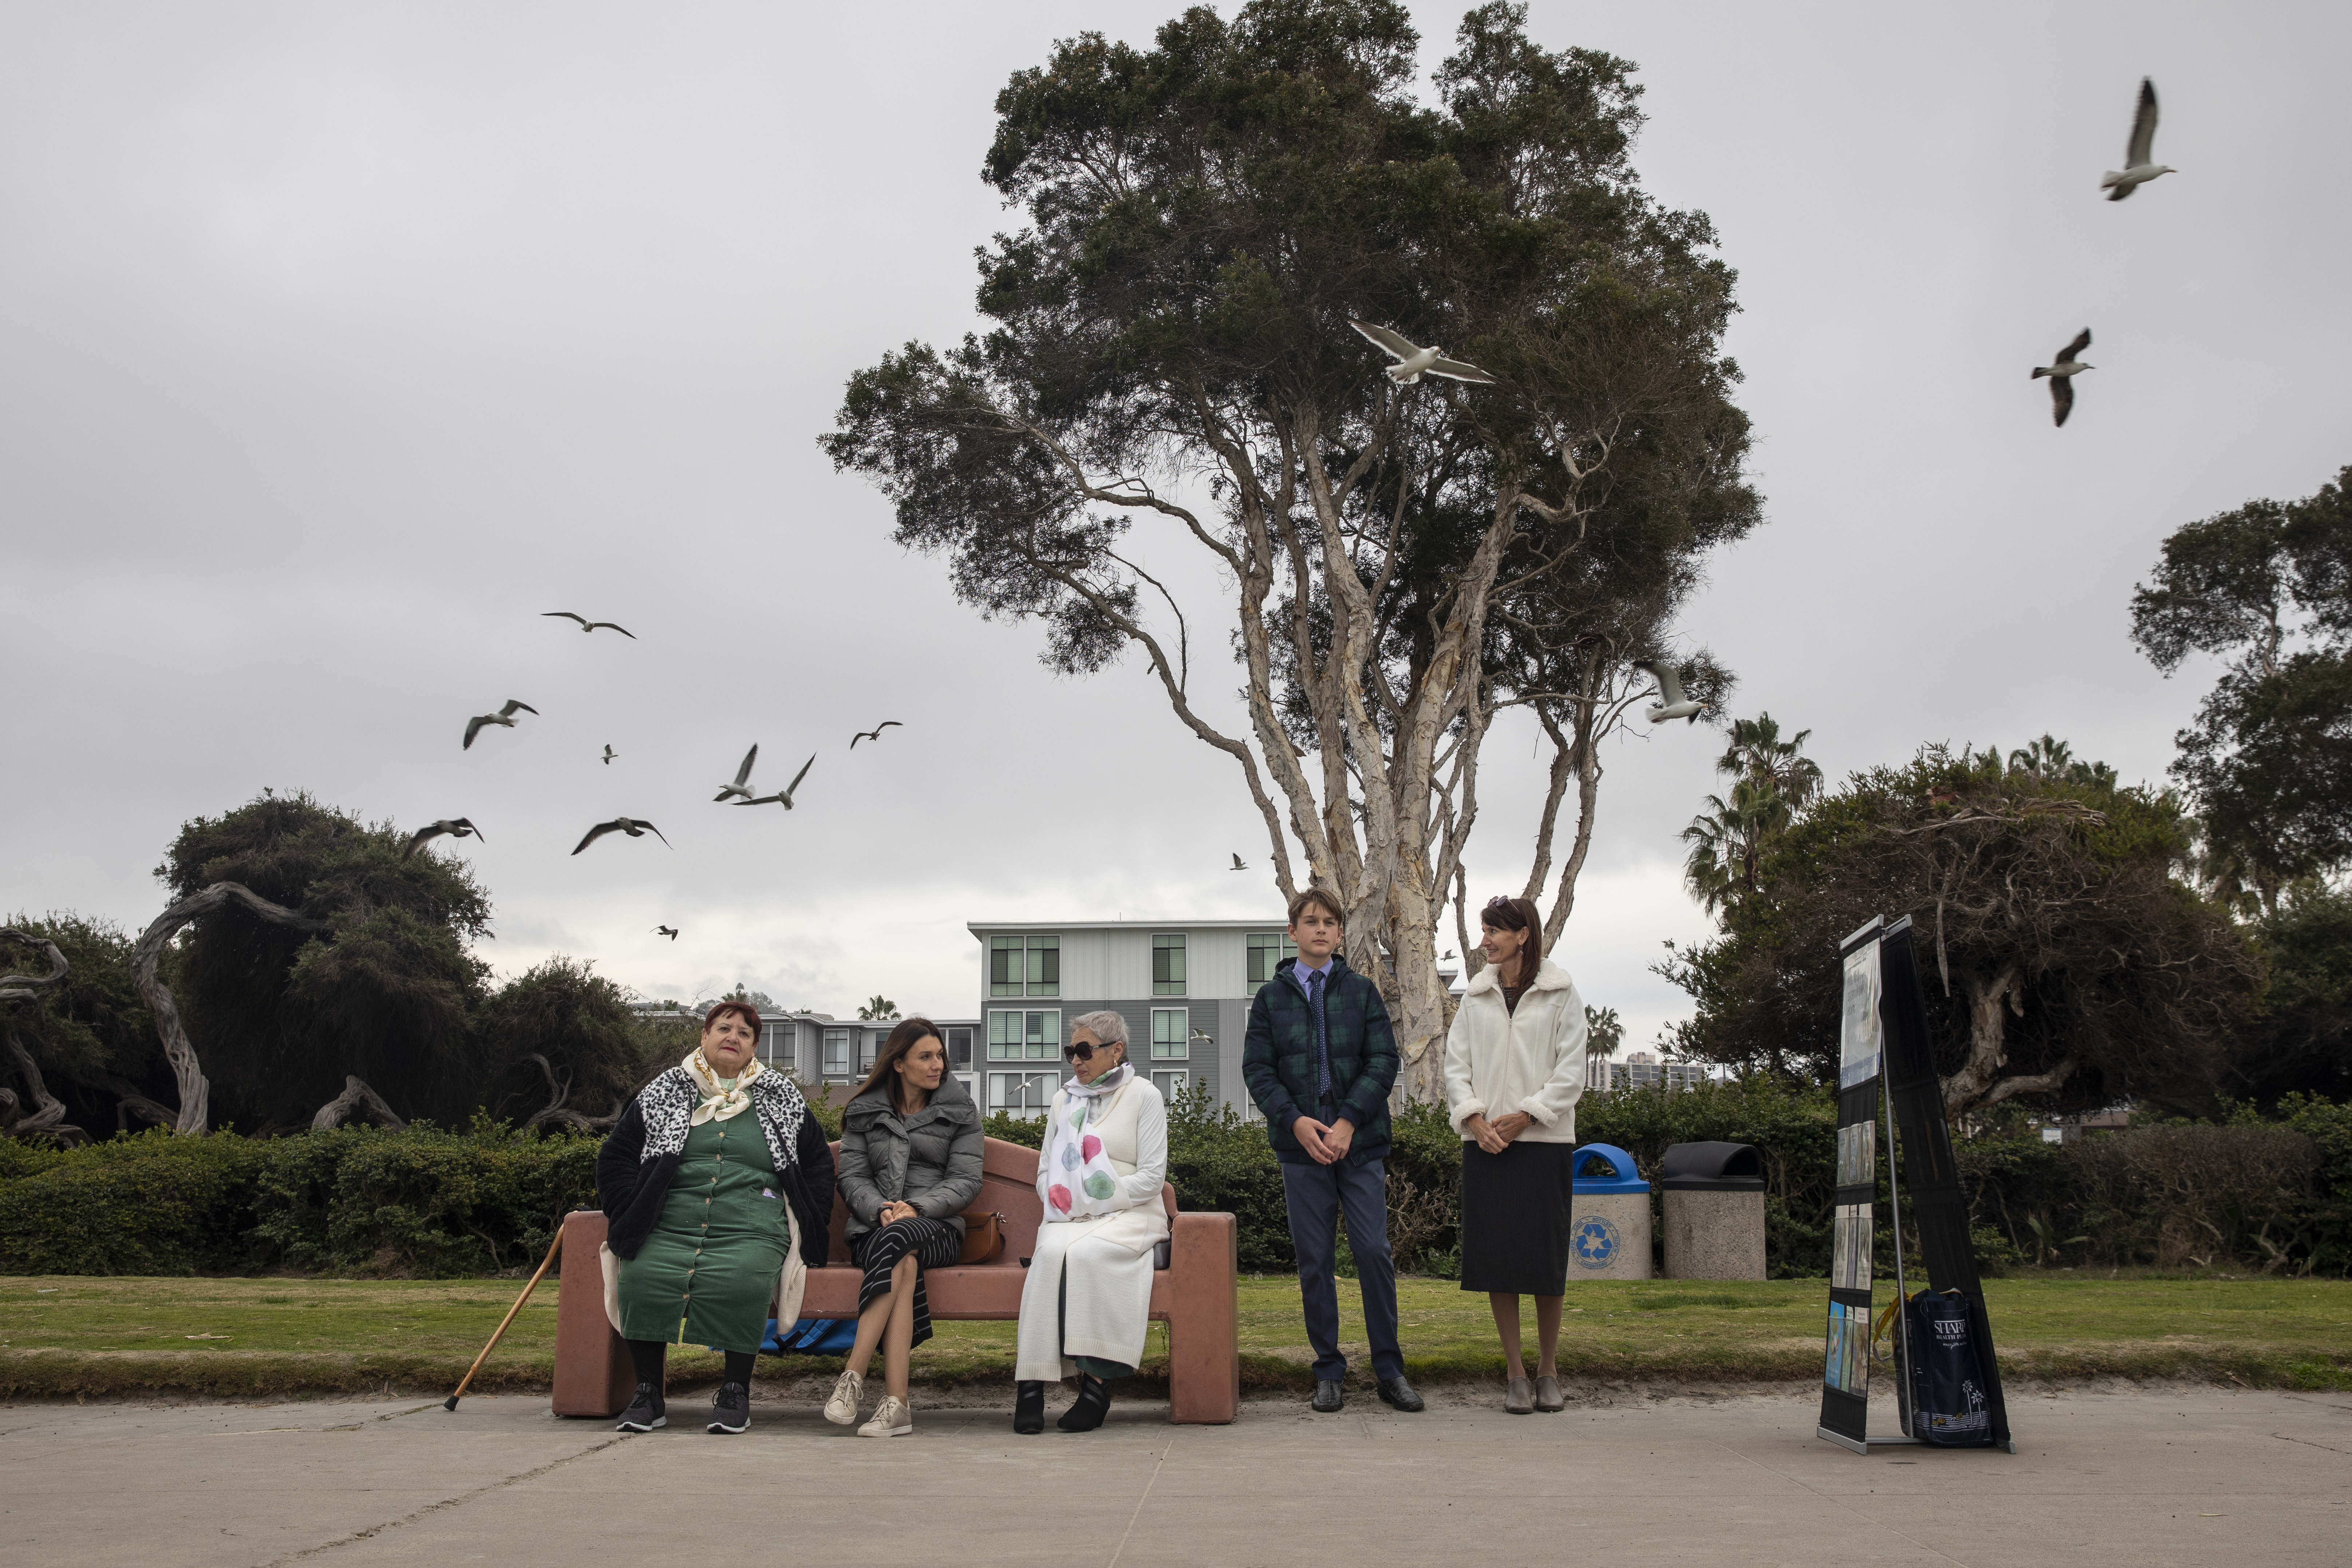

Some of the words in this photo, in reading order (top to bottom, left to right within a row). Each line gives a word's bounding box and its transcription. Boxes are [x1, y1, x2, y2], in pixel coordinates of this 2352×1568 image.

[1574, 1220, 1583, 1230] CANS
[1593, 1217, 1611, 1228] BOTTLES
[1934, 1322, 1965, 1333] SHARP
